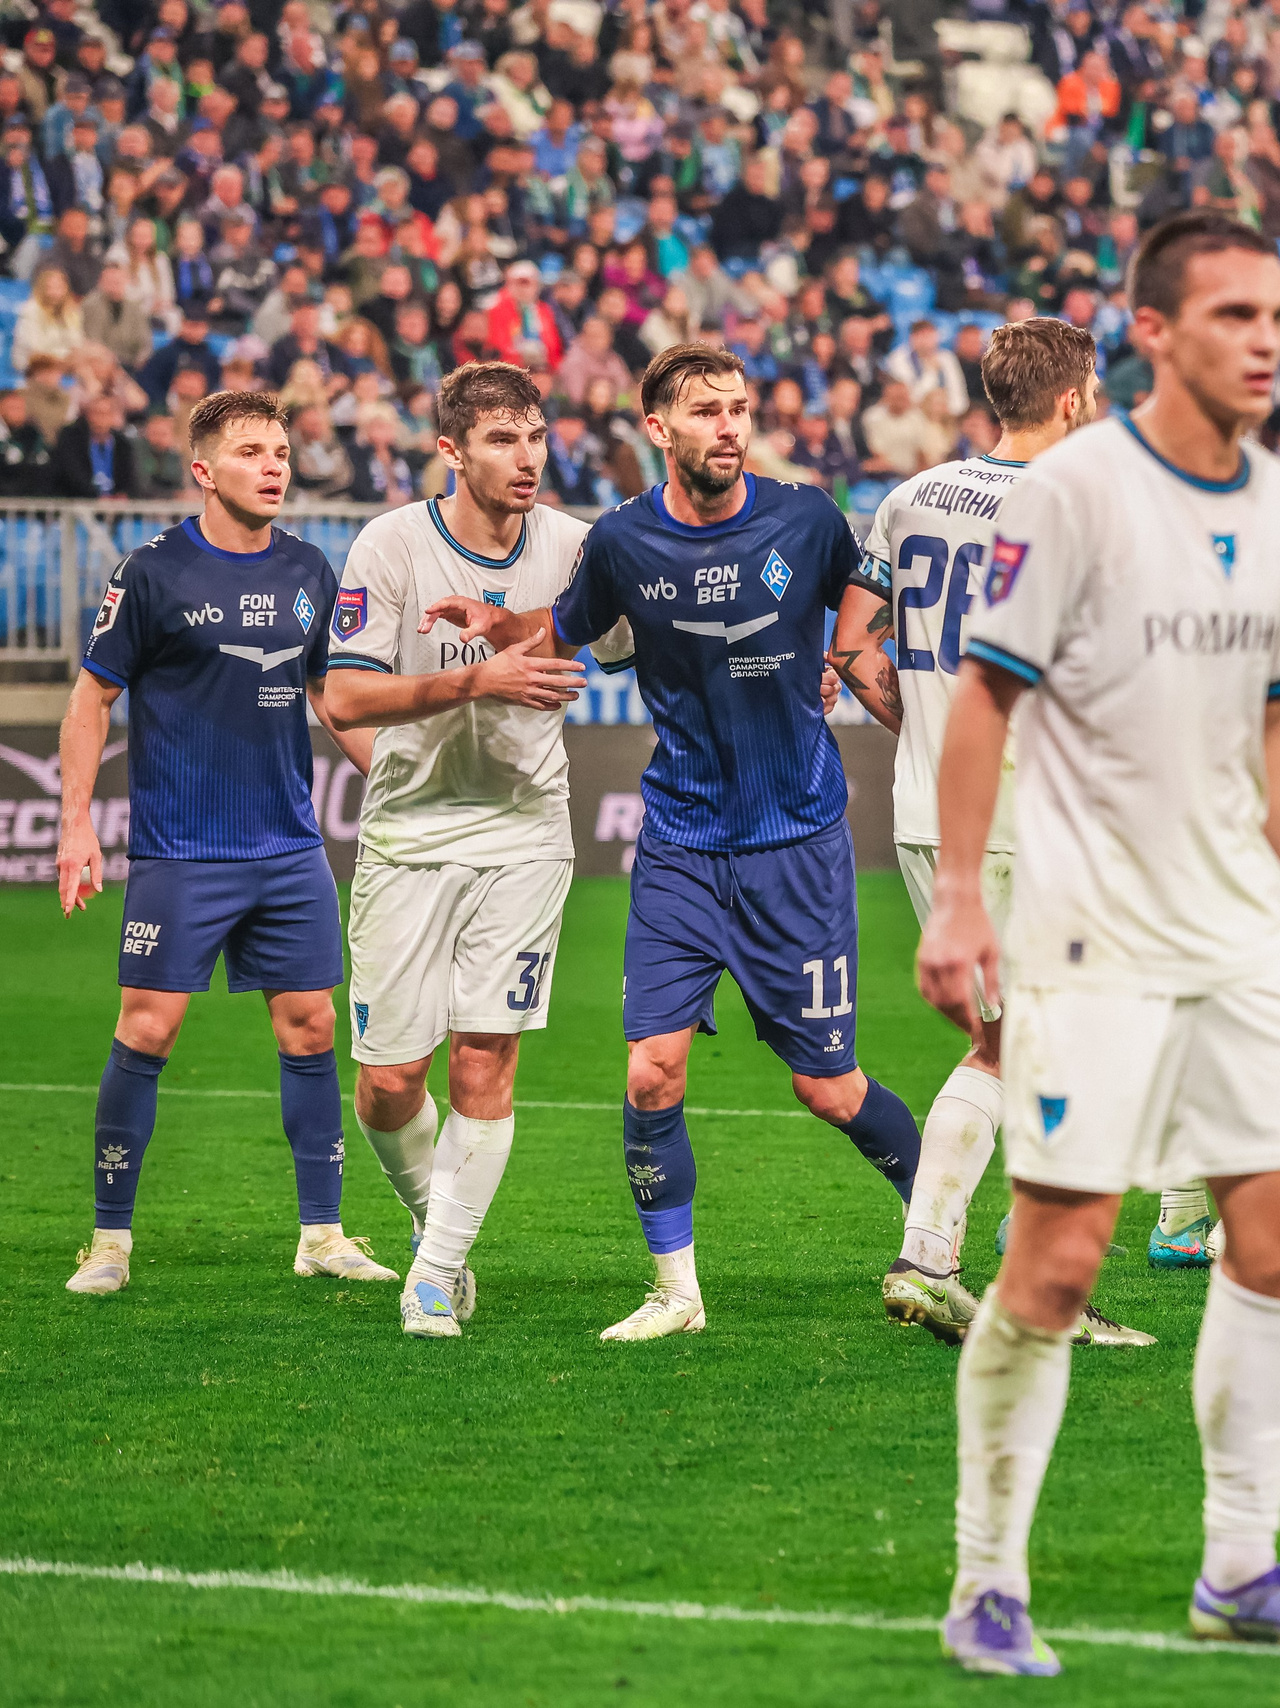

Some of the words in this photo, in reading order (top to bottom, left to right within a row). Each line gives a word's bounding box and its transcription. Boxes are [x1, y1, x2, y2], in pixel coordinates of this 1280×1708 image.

[910, 481, 1003, 522] МЕЩАНИ
[694, 564, 739, 586] FON
[638, 577, 678, 600] wb
[697, 583, 741, 605] BET
[240, 594, 275, 610] FON
[184, 603, 224, 626] wb
[242, 611, 278, 627] BET
[728, 652, 795, 664] ПРАВИТЕЛЬСТВО
[729, 662, 780, 671] САМАРСКОЙ
[730, 670, 769, 679] ОБЛАСТИ
[258, 686, 303, 694] ПРАВИТЕЛЬСТ
[125, 921, 162, 940] FON
[123, 937, 159, 956] BET
[801, 955, 853, 1018] 11
[823, 1043, 845, 1053] KELME
[97, 1160, 130, 1170] KELME
